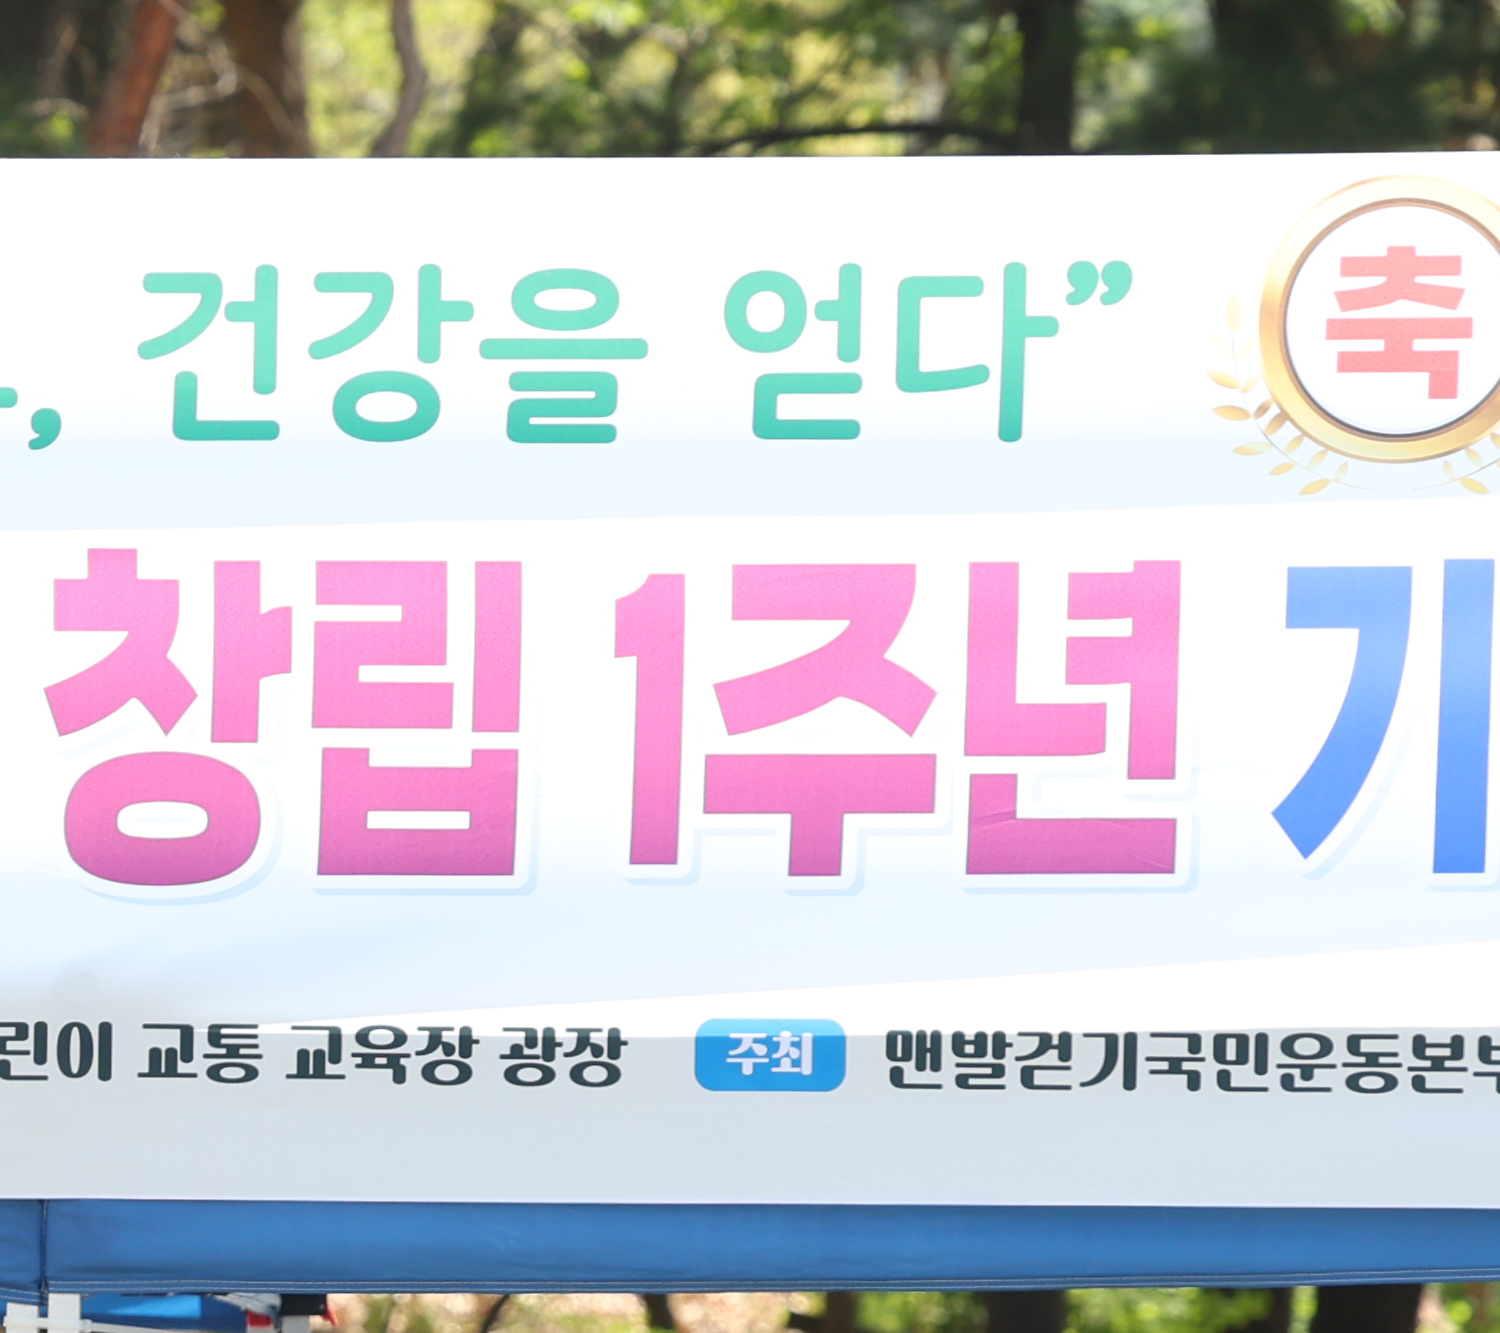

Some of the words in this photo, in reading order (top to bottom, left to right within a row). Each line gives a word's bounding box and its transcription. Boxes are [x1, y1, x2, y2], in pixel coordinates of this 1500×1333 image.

[139, 265, 647, 443] 건강을
[726, 262, 1131, 442] 얻다”
[1325, 245, 1476, 400] 축
[46, 549, 521, 885] 창립
[616, 561, 1180, 876] 1주년
[138, 1024, 262, 1083] 교통
[286, 1027, 479, 1085] 교육장
[500, 1028, 627, 1087] 광장
[726, 1028, 815, 1077] 주최
